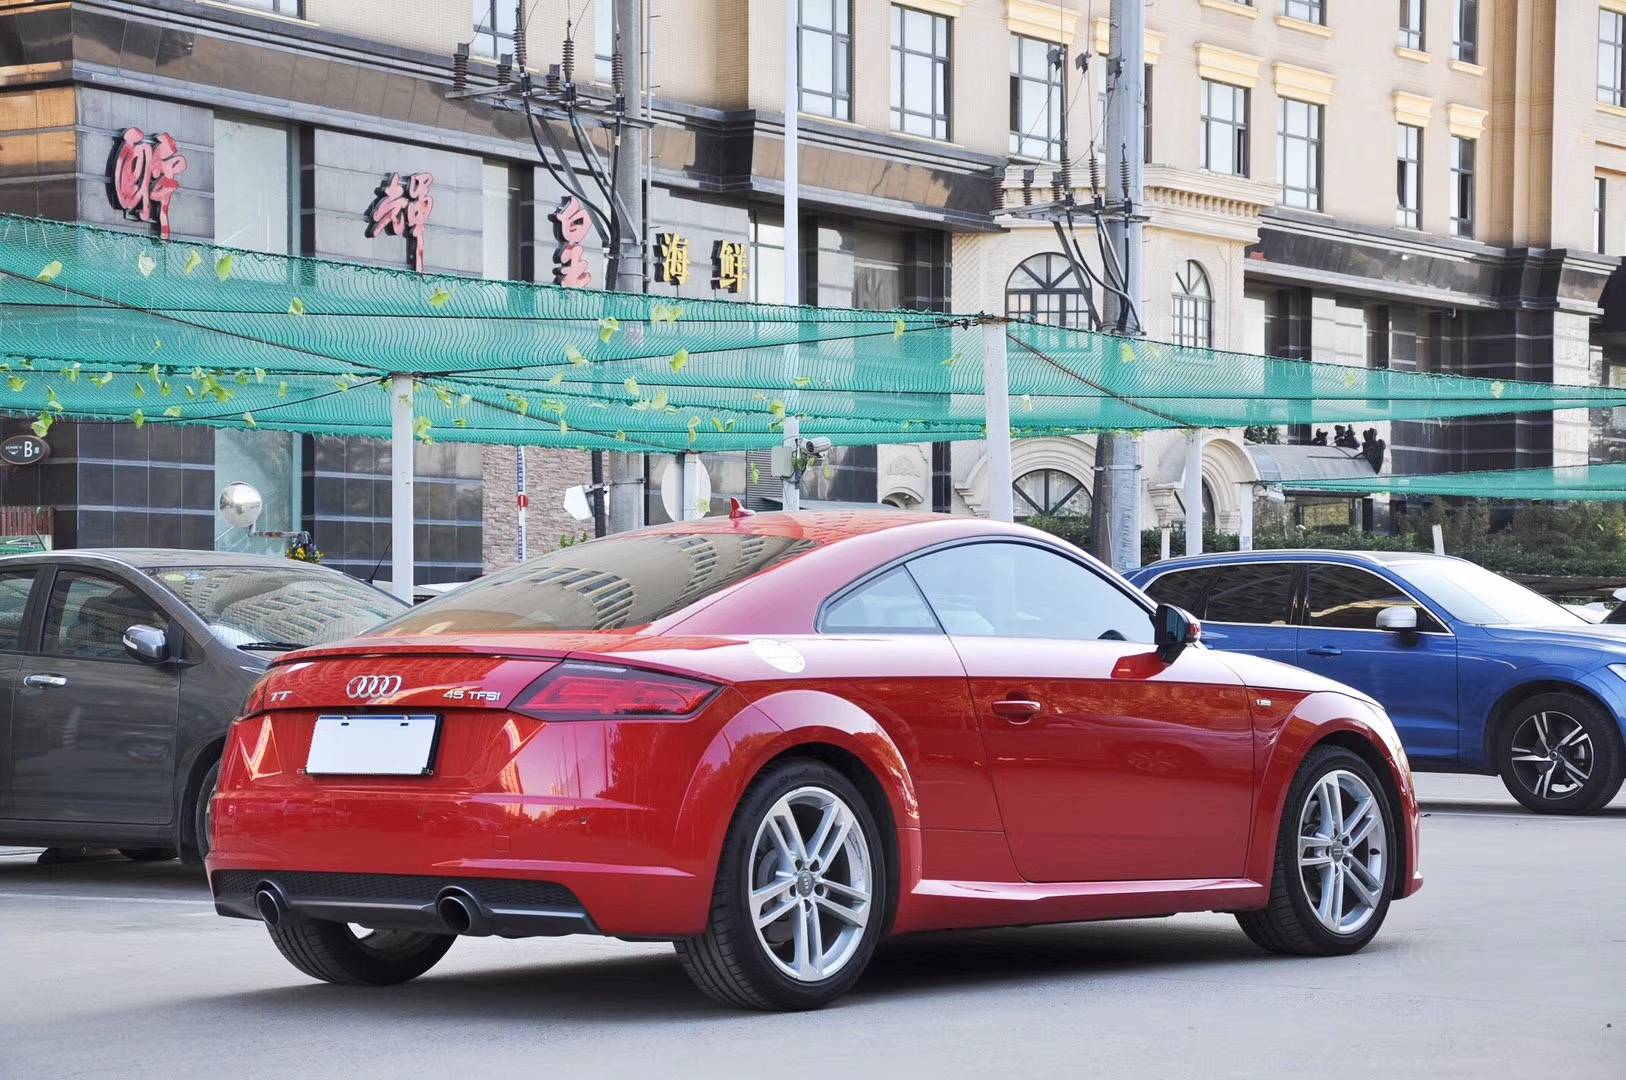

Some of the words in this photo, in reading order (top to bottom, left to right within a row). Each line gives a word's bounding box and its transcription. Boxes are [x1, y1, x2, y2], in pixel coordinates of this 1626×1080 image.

[24, 440, 33, 458] B
[270, 690, 293, 702] TT
[442, 689, 465, 700] 45
[467, 690, 501, 702] TFSI
